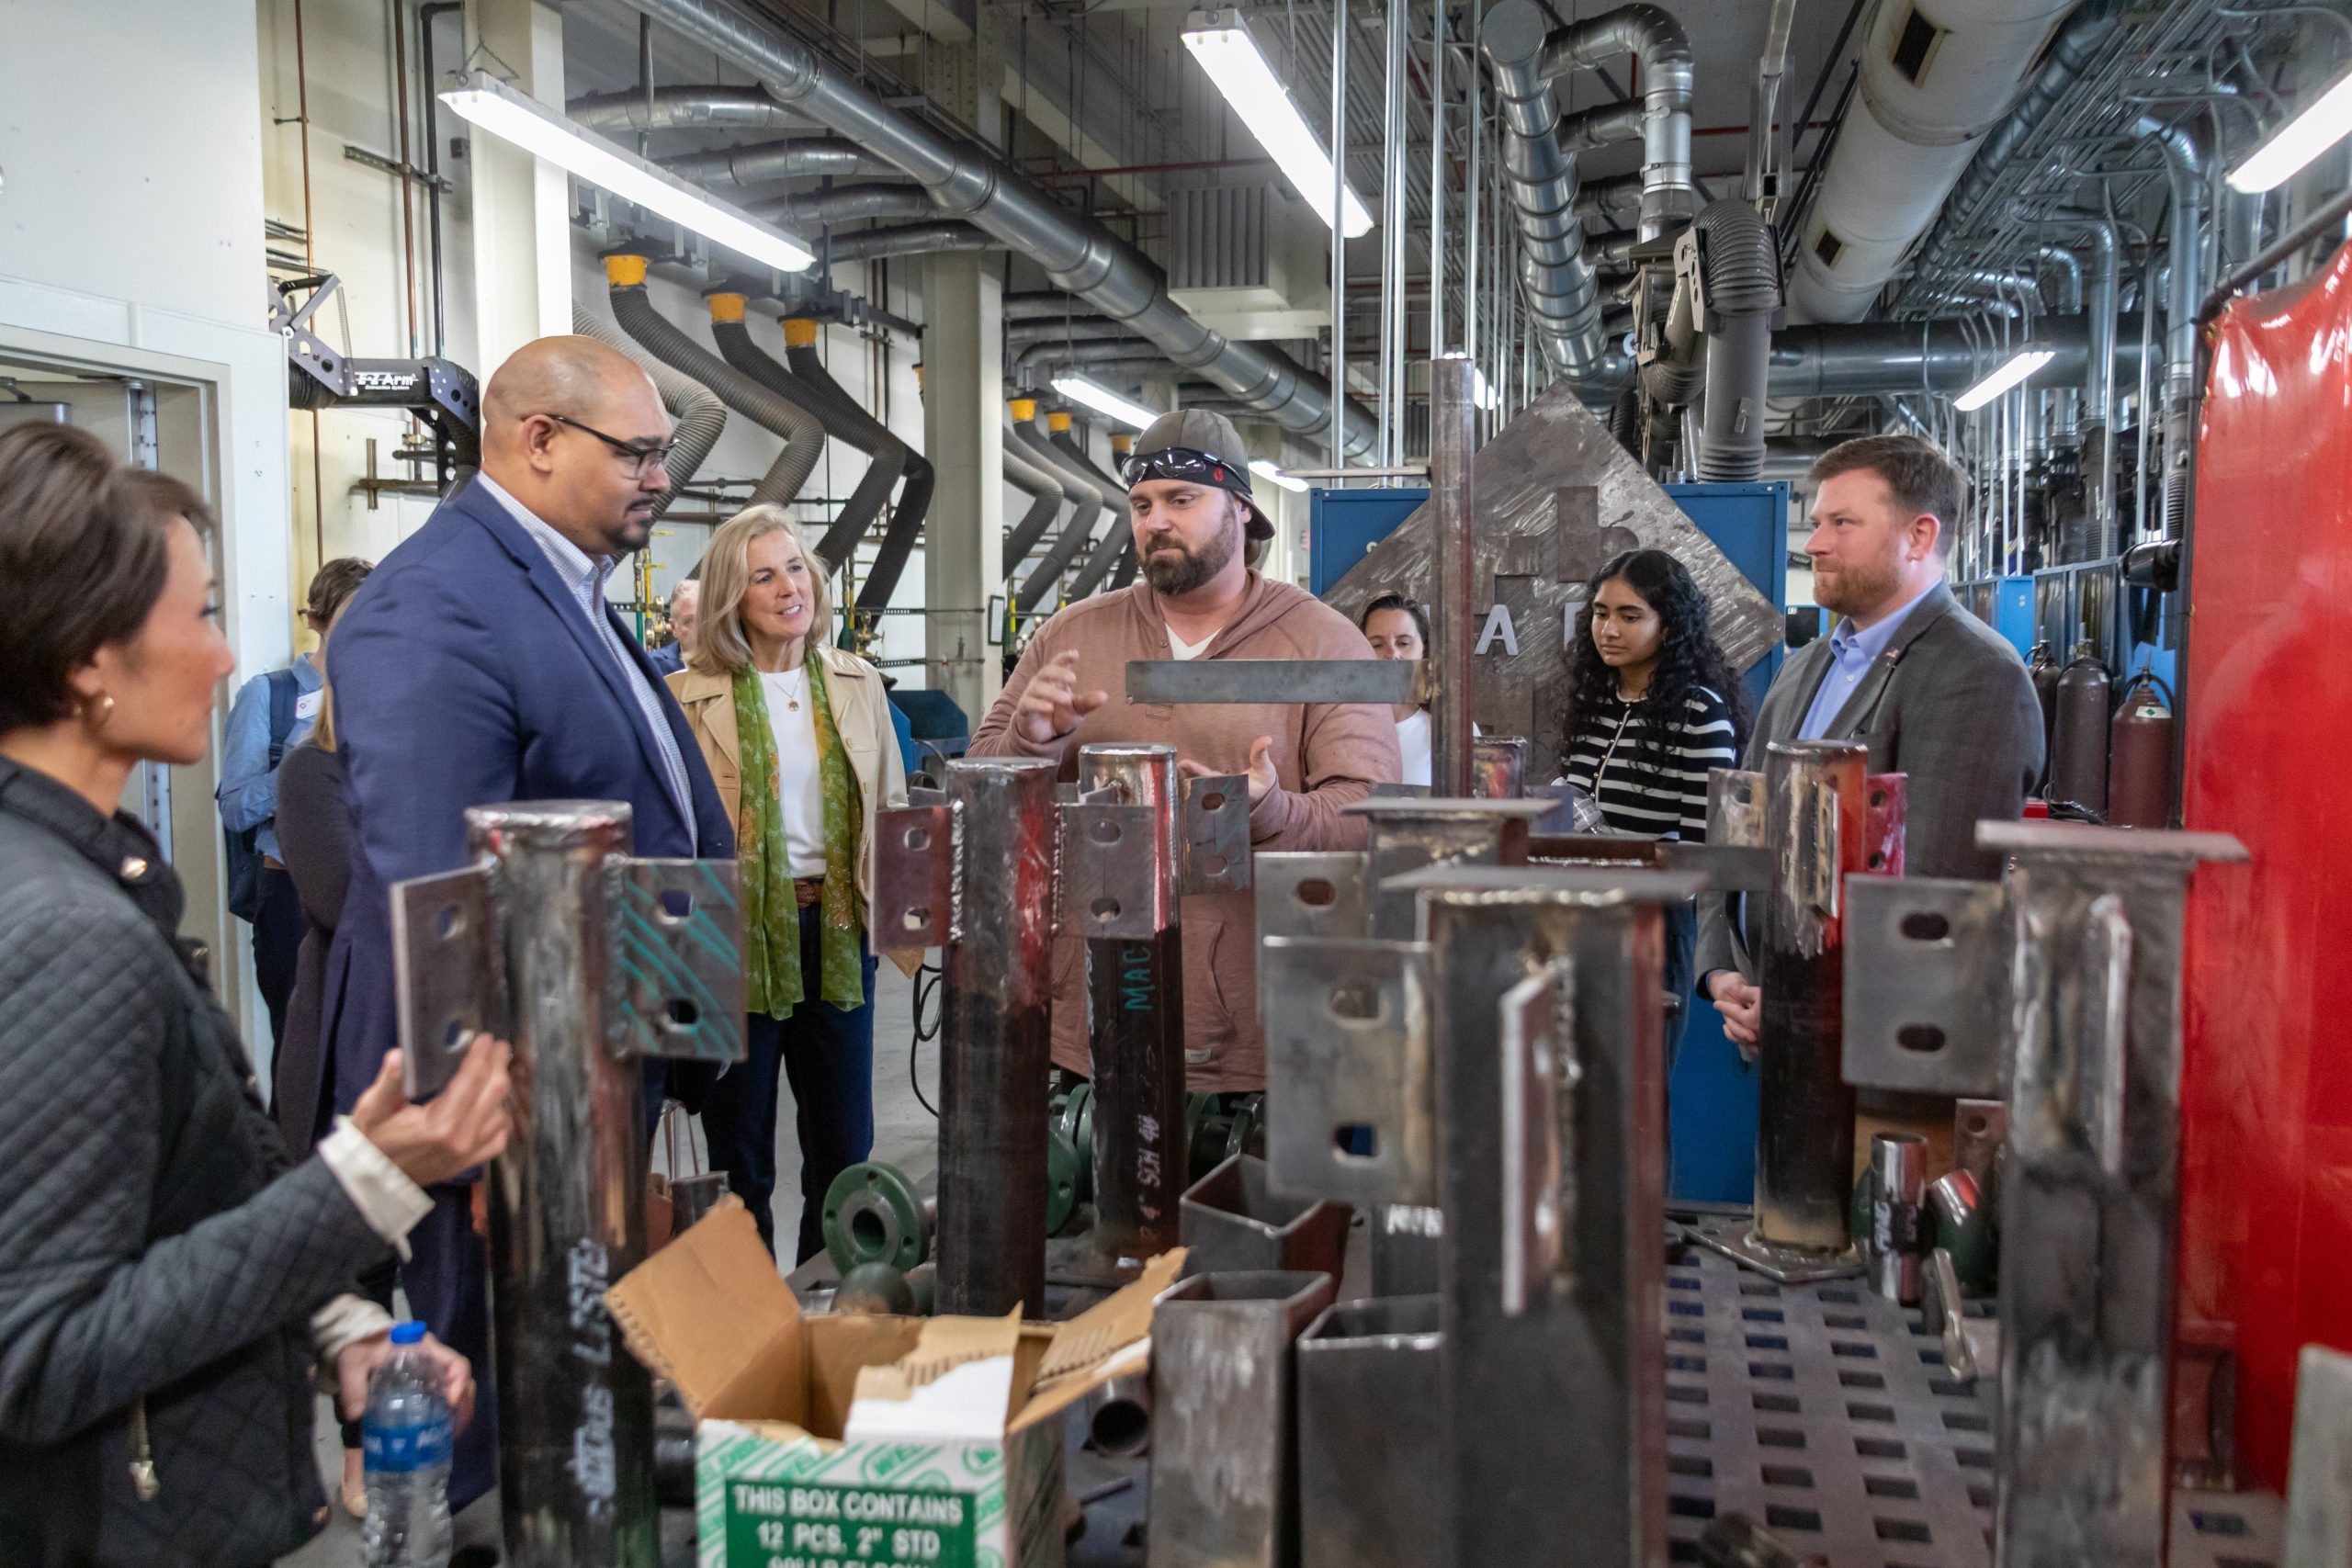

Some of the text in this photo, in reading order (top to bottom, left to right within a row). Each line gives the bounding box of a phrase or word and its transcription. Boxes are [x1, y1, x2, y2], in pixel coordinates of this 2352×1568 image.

[1122, 945, 1156, 1010] MAC
[733, 1483, 786, 1514] THIS
[789, 1486, 840, 1517] BOX
[842, 1490, 964, 1528] CONTAINS
[756, 1520, 785, 1551] 12
[793, 1522, 847, 1555] PCS.
[855, 1526, 883, 1557] 2"
[891, 1528, 941, 1561] STD
